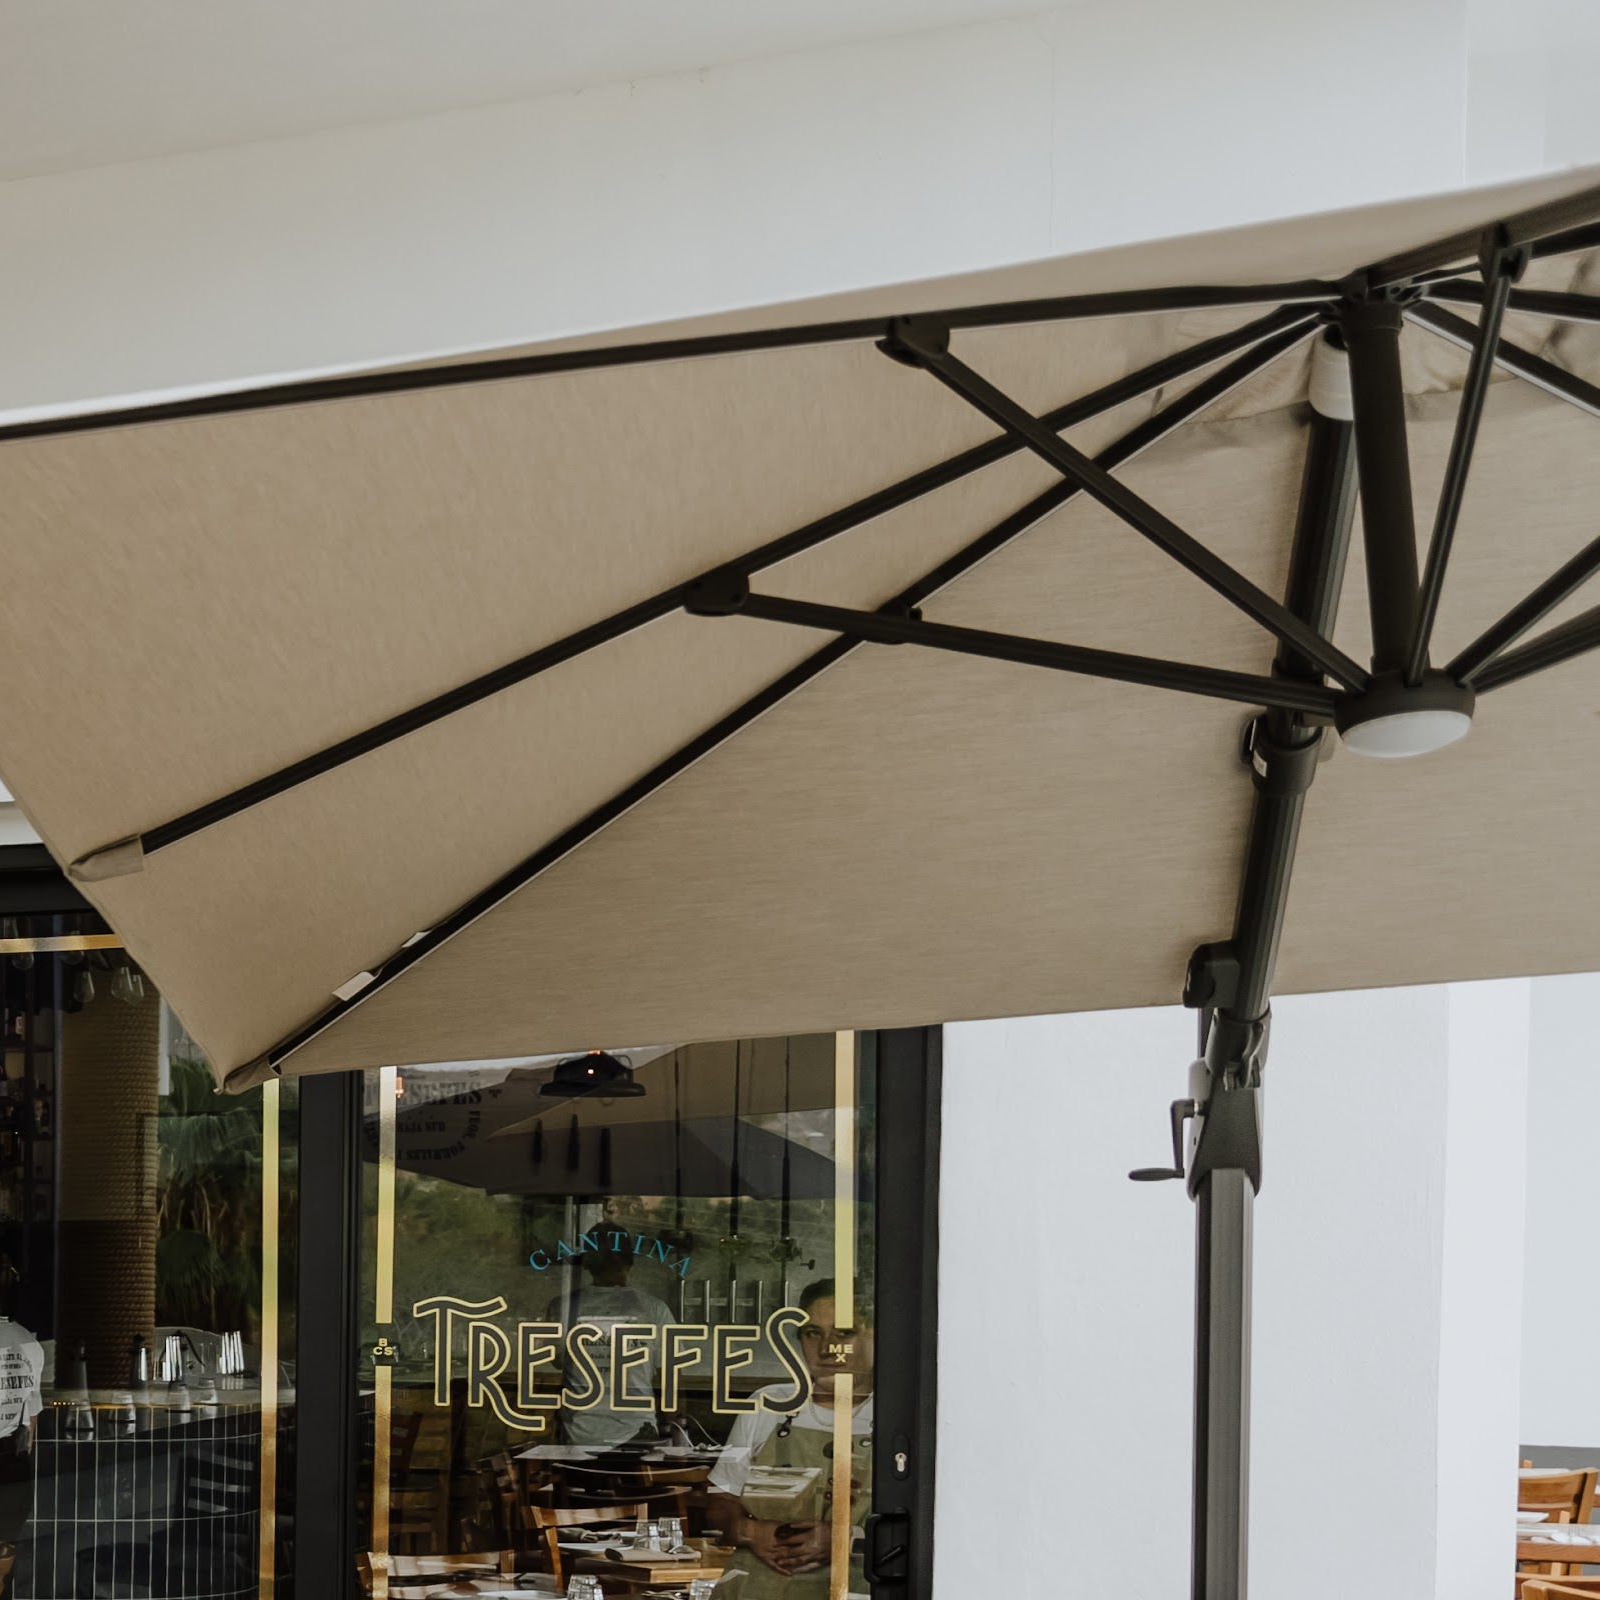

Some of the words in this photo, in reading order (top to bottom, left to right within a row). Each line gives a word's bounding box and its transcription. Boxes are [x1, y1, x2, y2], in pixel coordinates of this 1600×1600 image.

[529, 1231, 691, 1278] CANTINA
[378, 1337, 389, 1347] B
[373, 1346, 393, 1356] CS
[828, 1343, 854, 1354] ME
[835, 1353, 847, 1363] X
[412, 1295, 813, 1432] TRESEFES
